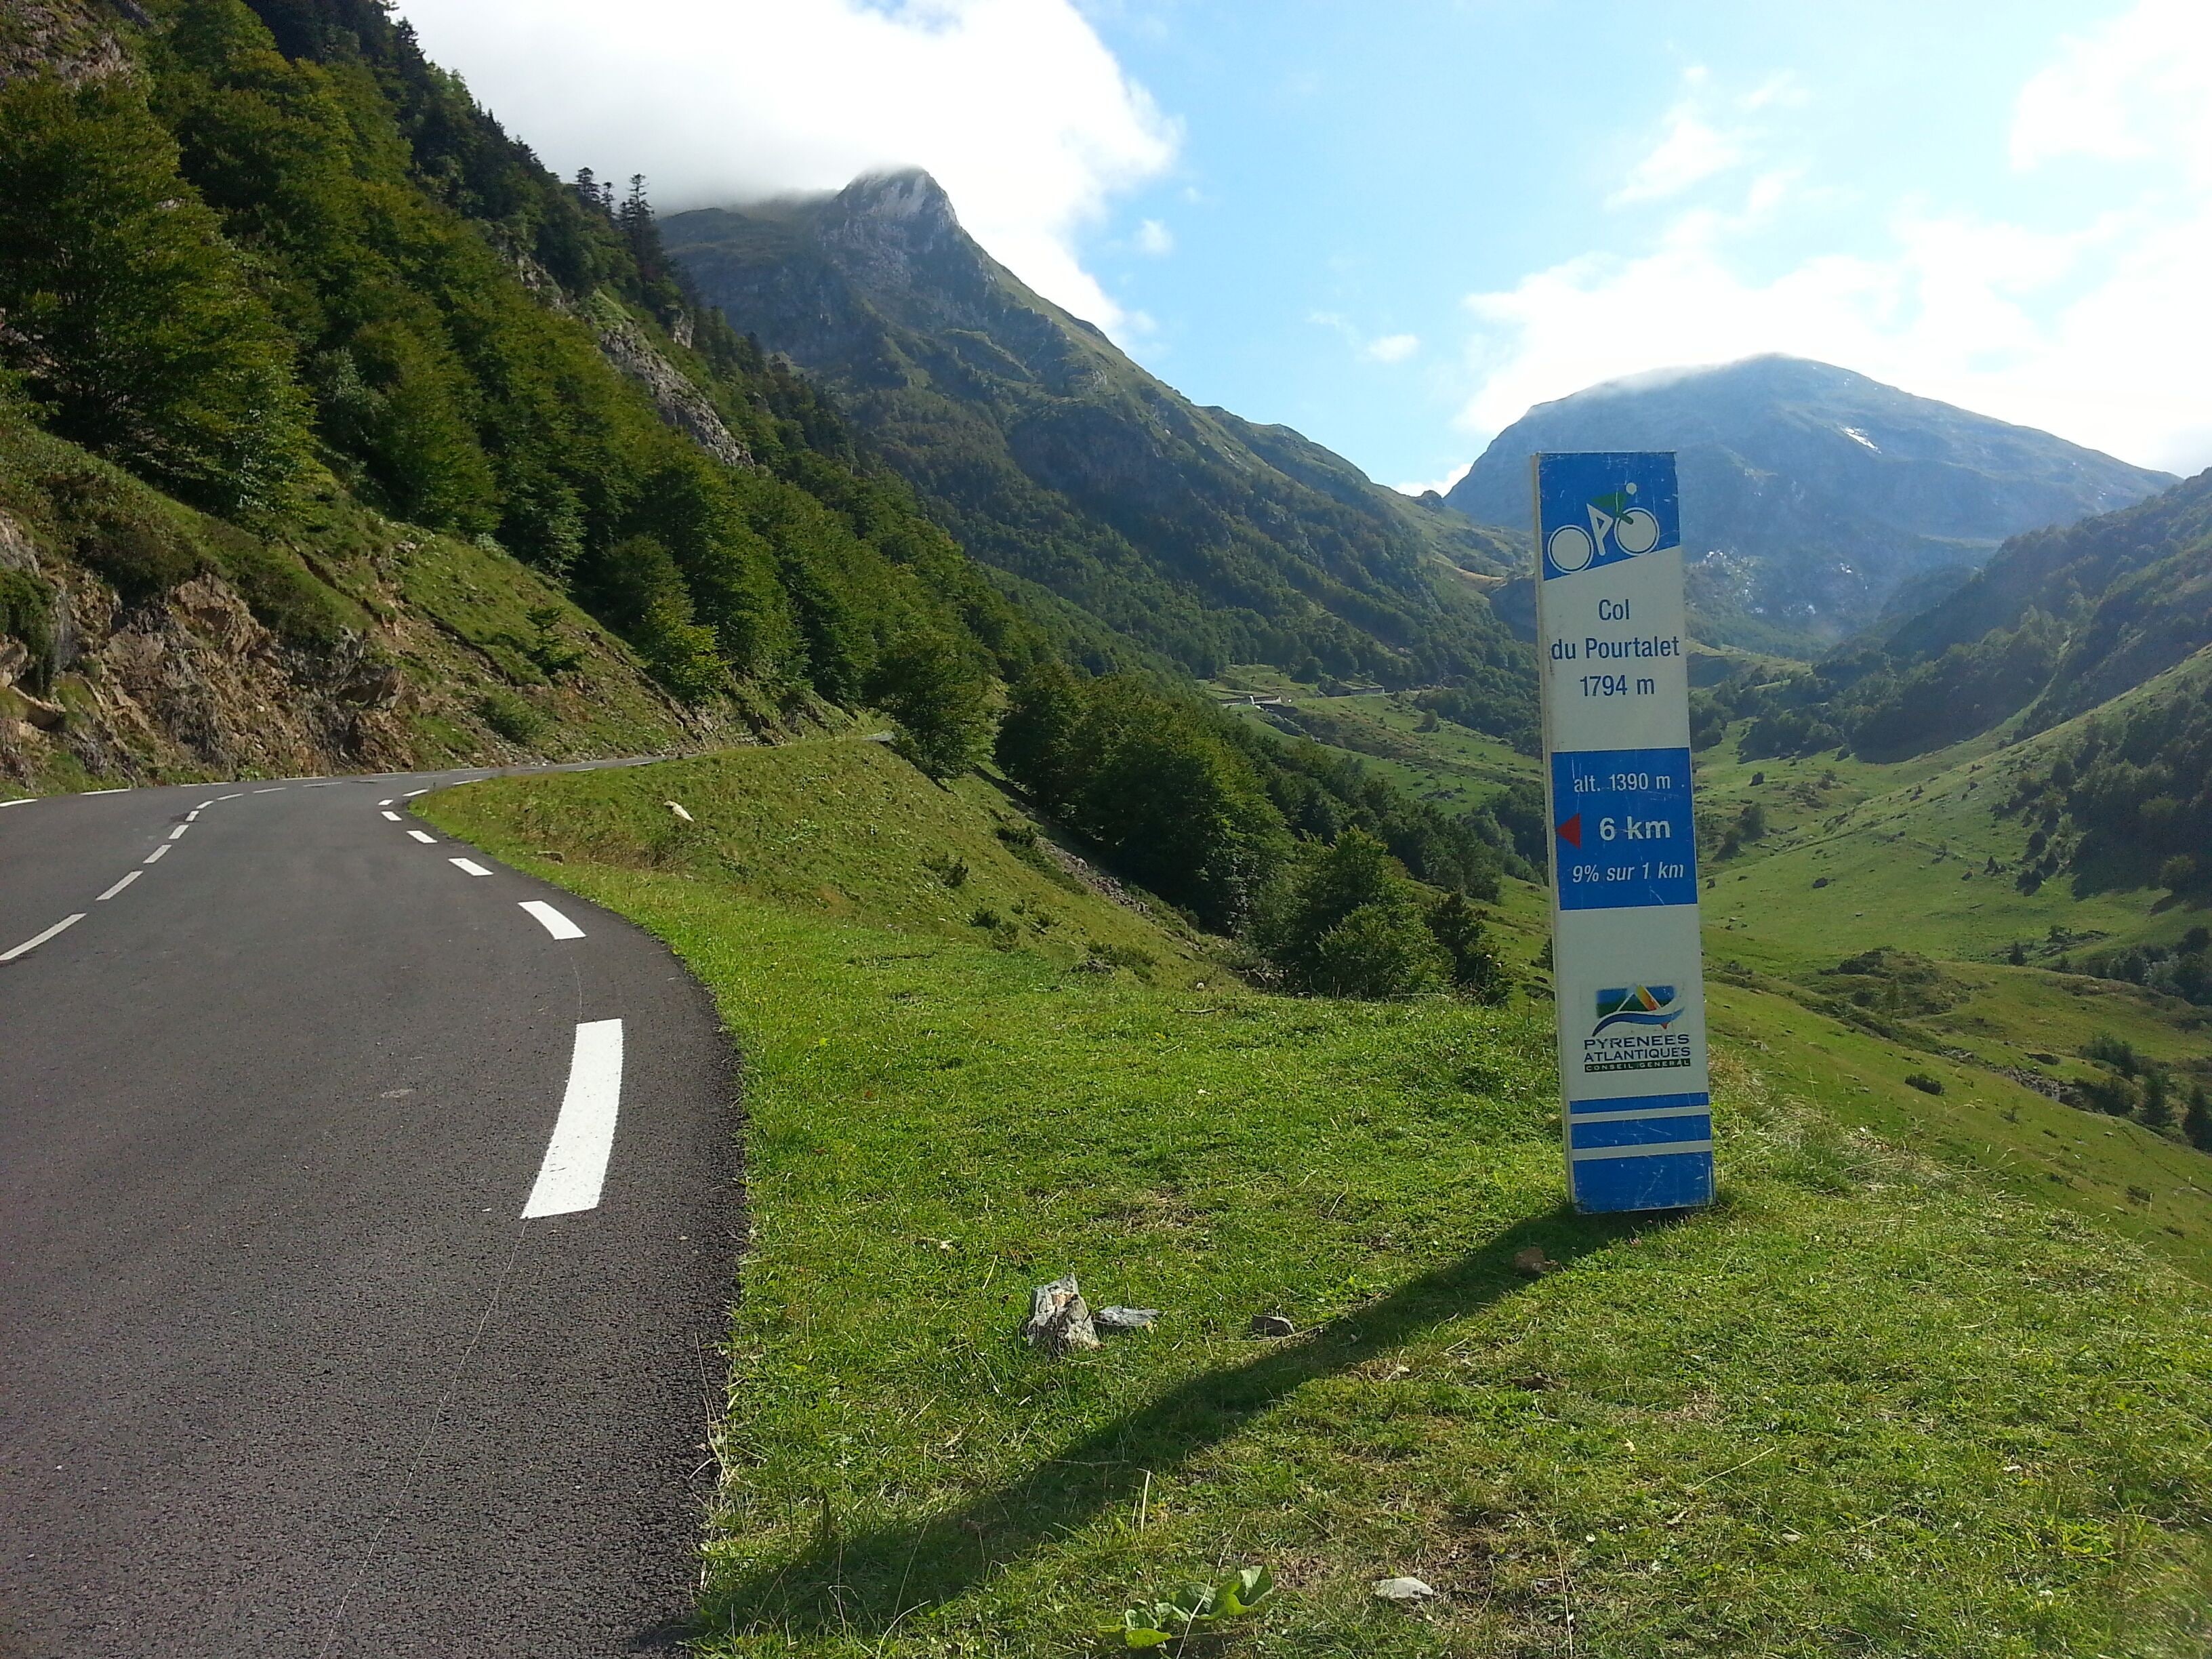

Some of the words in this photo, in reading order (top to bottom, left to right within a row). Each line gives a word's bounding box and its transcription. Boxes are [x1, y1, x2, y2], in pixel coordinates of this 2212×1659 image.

[1599, 598, 1629, 621] Col
[1551, 638, 1576, 659] du
[1586, 636, 1679, 658] Pourtalet
[1580, 675, 1627, 697] 1794
[1637, 678, 1654, 695] m
[1574, 775, 1601, 792] alt.
[1609, 773, 1648, 791] 1390
[1656, 775, 1671, 789] m
[1599, 817, 1616, 841] 6
[1627, 816, 1671, 840] km
[1572, 864, 1599, 883] 9%
[1606, 866, 1635, 881] sur
[1642, 862, 1650, 880] 1
[1658, 862, 1684, 878] km
[1584, 1046, 1691, 1063] ATLANTIQUES
[1586, 1063, 1634, 1071] CONSEIL
